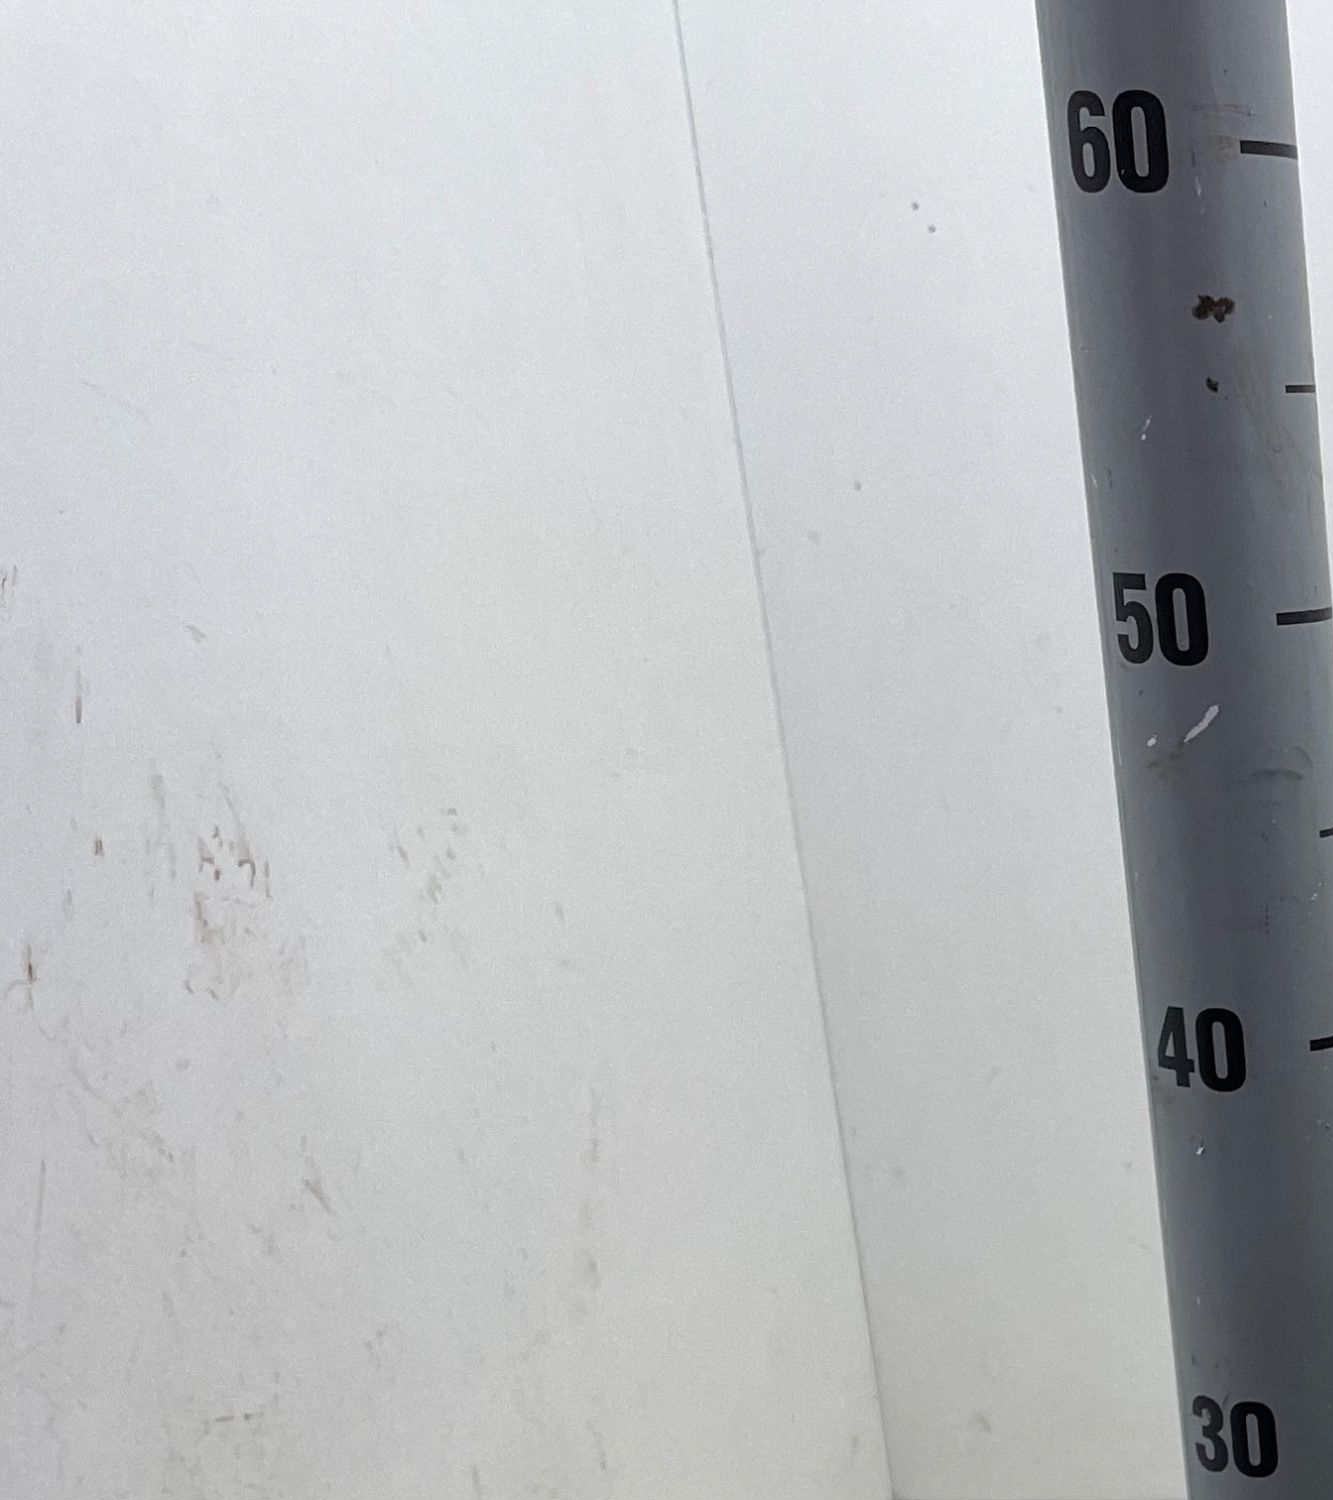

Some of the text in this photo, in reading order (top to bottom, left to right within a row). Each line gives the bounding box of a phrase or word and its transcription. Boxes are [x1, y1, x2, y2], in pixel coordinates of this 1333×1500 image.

[1066, 89, 1170, 194] 60
[1112, 572, 1209, 667] 50
[1157, 1005, 1247, 1092] 40
[1191, 1394, 1279, 1478] 30
